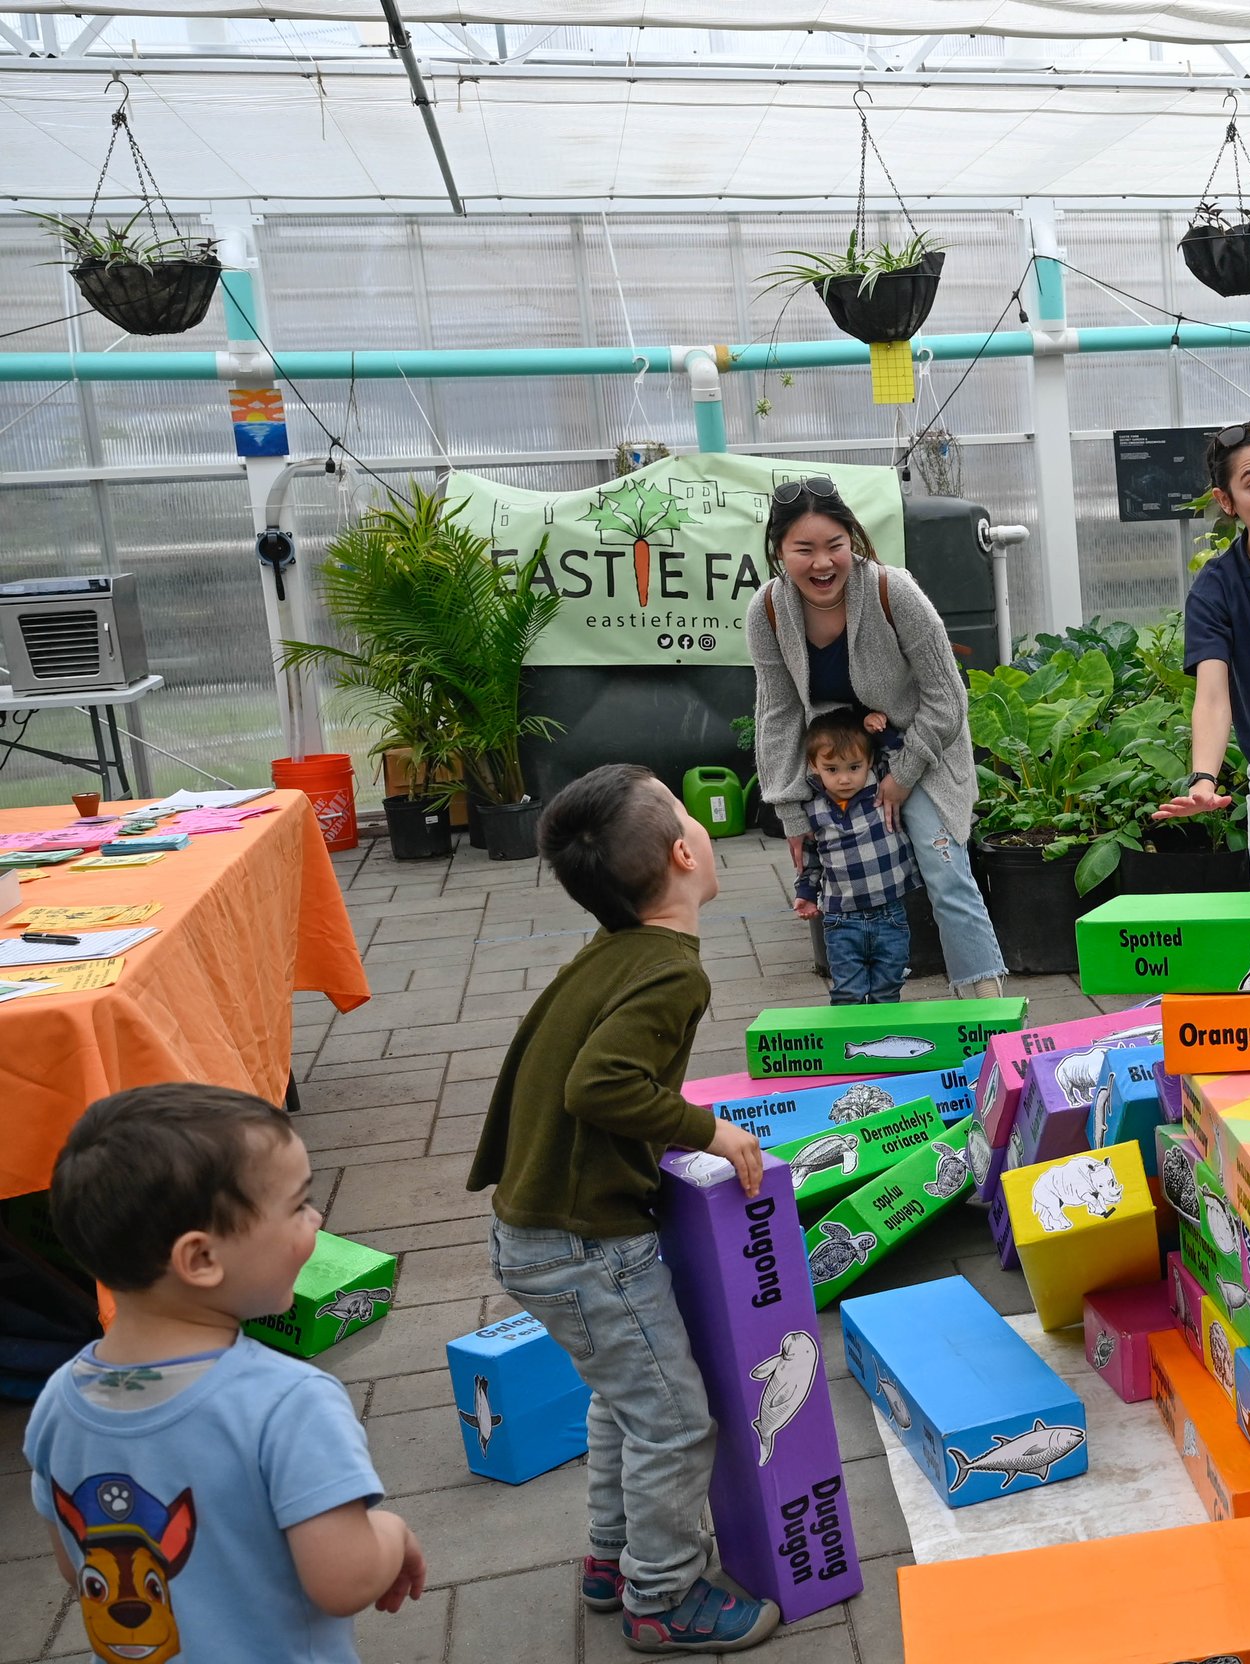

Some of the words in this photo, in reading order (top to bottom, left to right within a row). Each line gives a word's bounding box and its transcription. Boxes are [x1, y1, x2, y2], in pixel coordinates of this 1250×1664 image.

[1119, 927, 1183, 953] Spotted
[1135, 957, 1169, 977] Owl
[757, 1033, 824, 1053] Atlantic
[1021, 1032, 1056, 1056] Fin
[762, 1054, 823, 1074] Salmon
[719, 1099, 797, 1122] American
[936, 1093, 973, 1114] meri
[860, 1109, 935, 1144] Dermochelys
[882, 1130, 929, 1155] coriacea
[872, 1184, 904, 1212] mydas
[883, 1198, 926, 1231] Chelonia
[743, 1196, 782, 1310] Dugong
[245, 1314, 302, 1345] Logge
[778, 1494, 810, 1586] Dugon
[811, 1474, 848, 1582] Dugong
